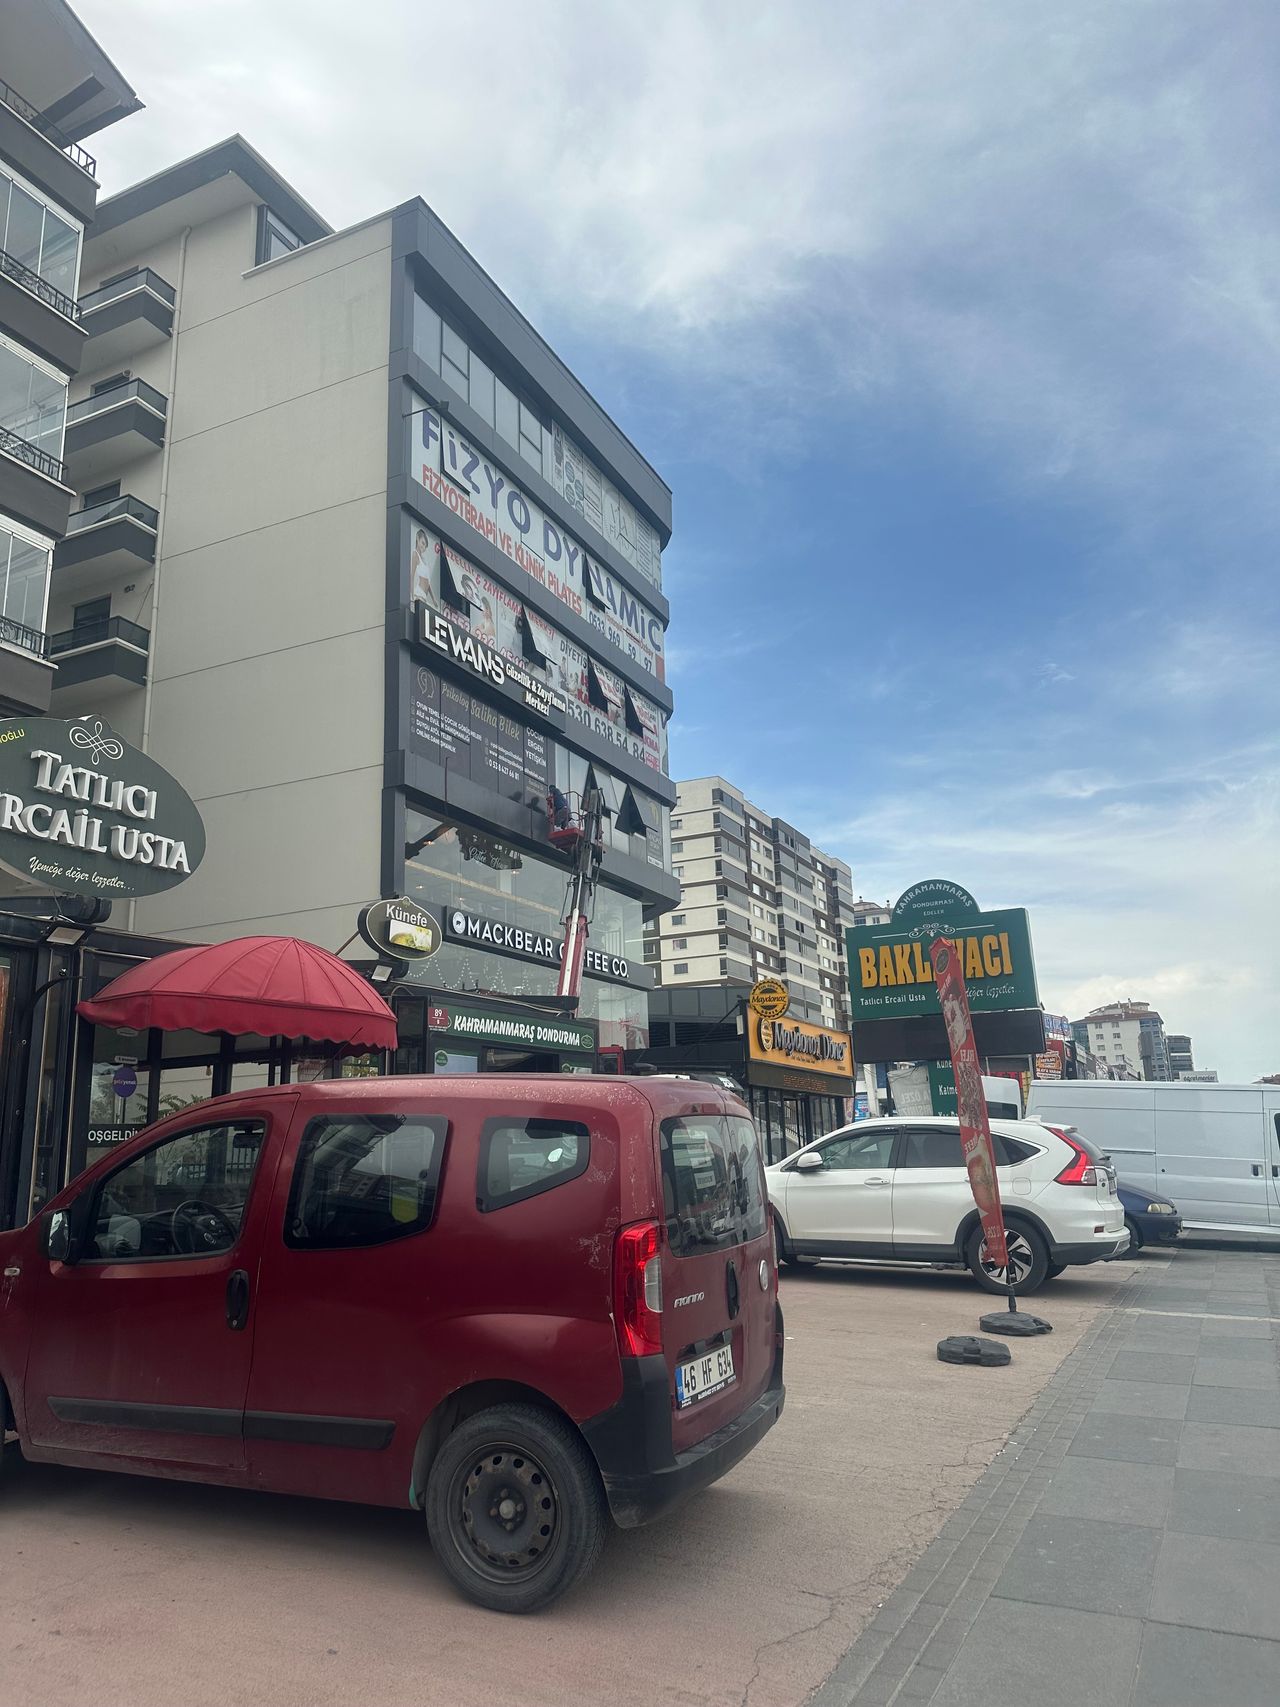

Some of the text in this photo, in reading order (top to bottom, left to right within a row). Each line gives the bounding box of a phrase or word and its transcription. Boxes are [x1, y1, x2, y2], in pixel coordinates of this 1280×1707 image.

[422, 464, 582, 615] FİZYOTERAPİ VE KLİNİK PİLATES
[424, 608, 505, 685] LEWANS
[506, 663, 531, 690] Güzellik
[441, 682, 520, 741] Psikolog Saliha Bilek
[525, 690, 550, 717] Merkezi
[0, 728, 25, 744] OĞLU
[30, 750, 157, 820] TATLICI
[0, 792, 191, 874] RCAİL USTA
[29, 856, 63, 878] Yemeğe
[65, 865, 89, 882] değer
[386, 903, 428, 928] Künefe
[467, 919, 553, 958] MACKBEAR
[559, 942, 608, 973] CFEE
[859, 932, 1013, 988] BAKLVACI
[908, 992, 926, 1002] Usta
[434, 1008, 443, 1017] 89
[453, 1014, 536, 1043] KAHRAMANMARAŞ
[536, 1025, 580, 1047] DONDURMA
[938, 1084, 958, 1096] Katme
[88, 1127, 139, 1144] OŞGELDİ
[683, 1365, 697, 1393] 46
[701, 1357, 712, 1386] HF
[717, 1349, 732, 1377] 634
